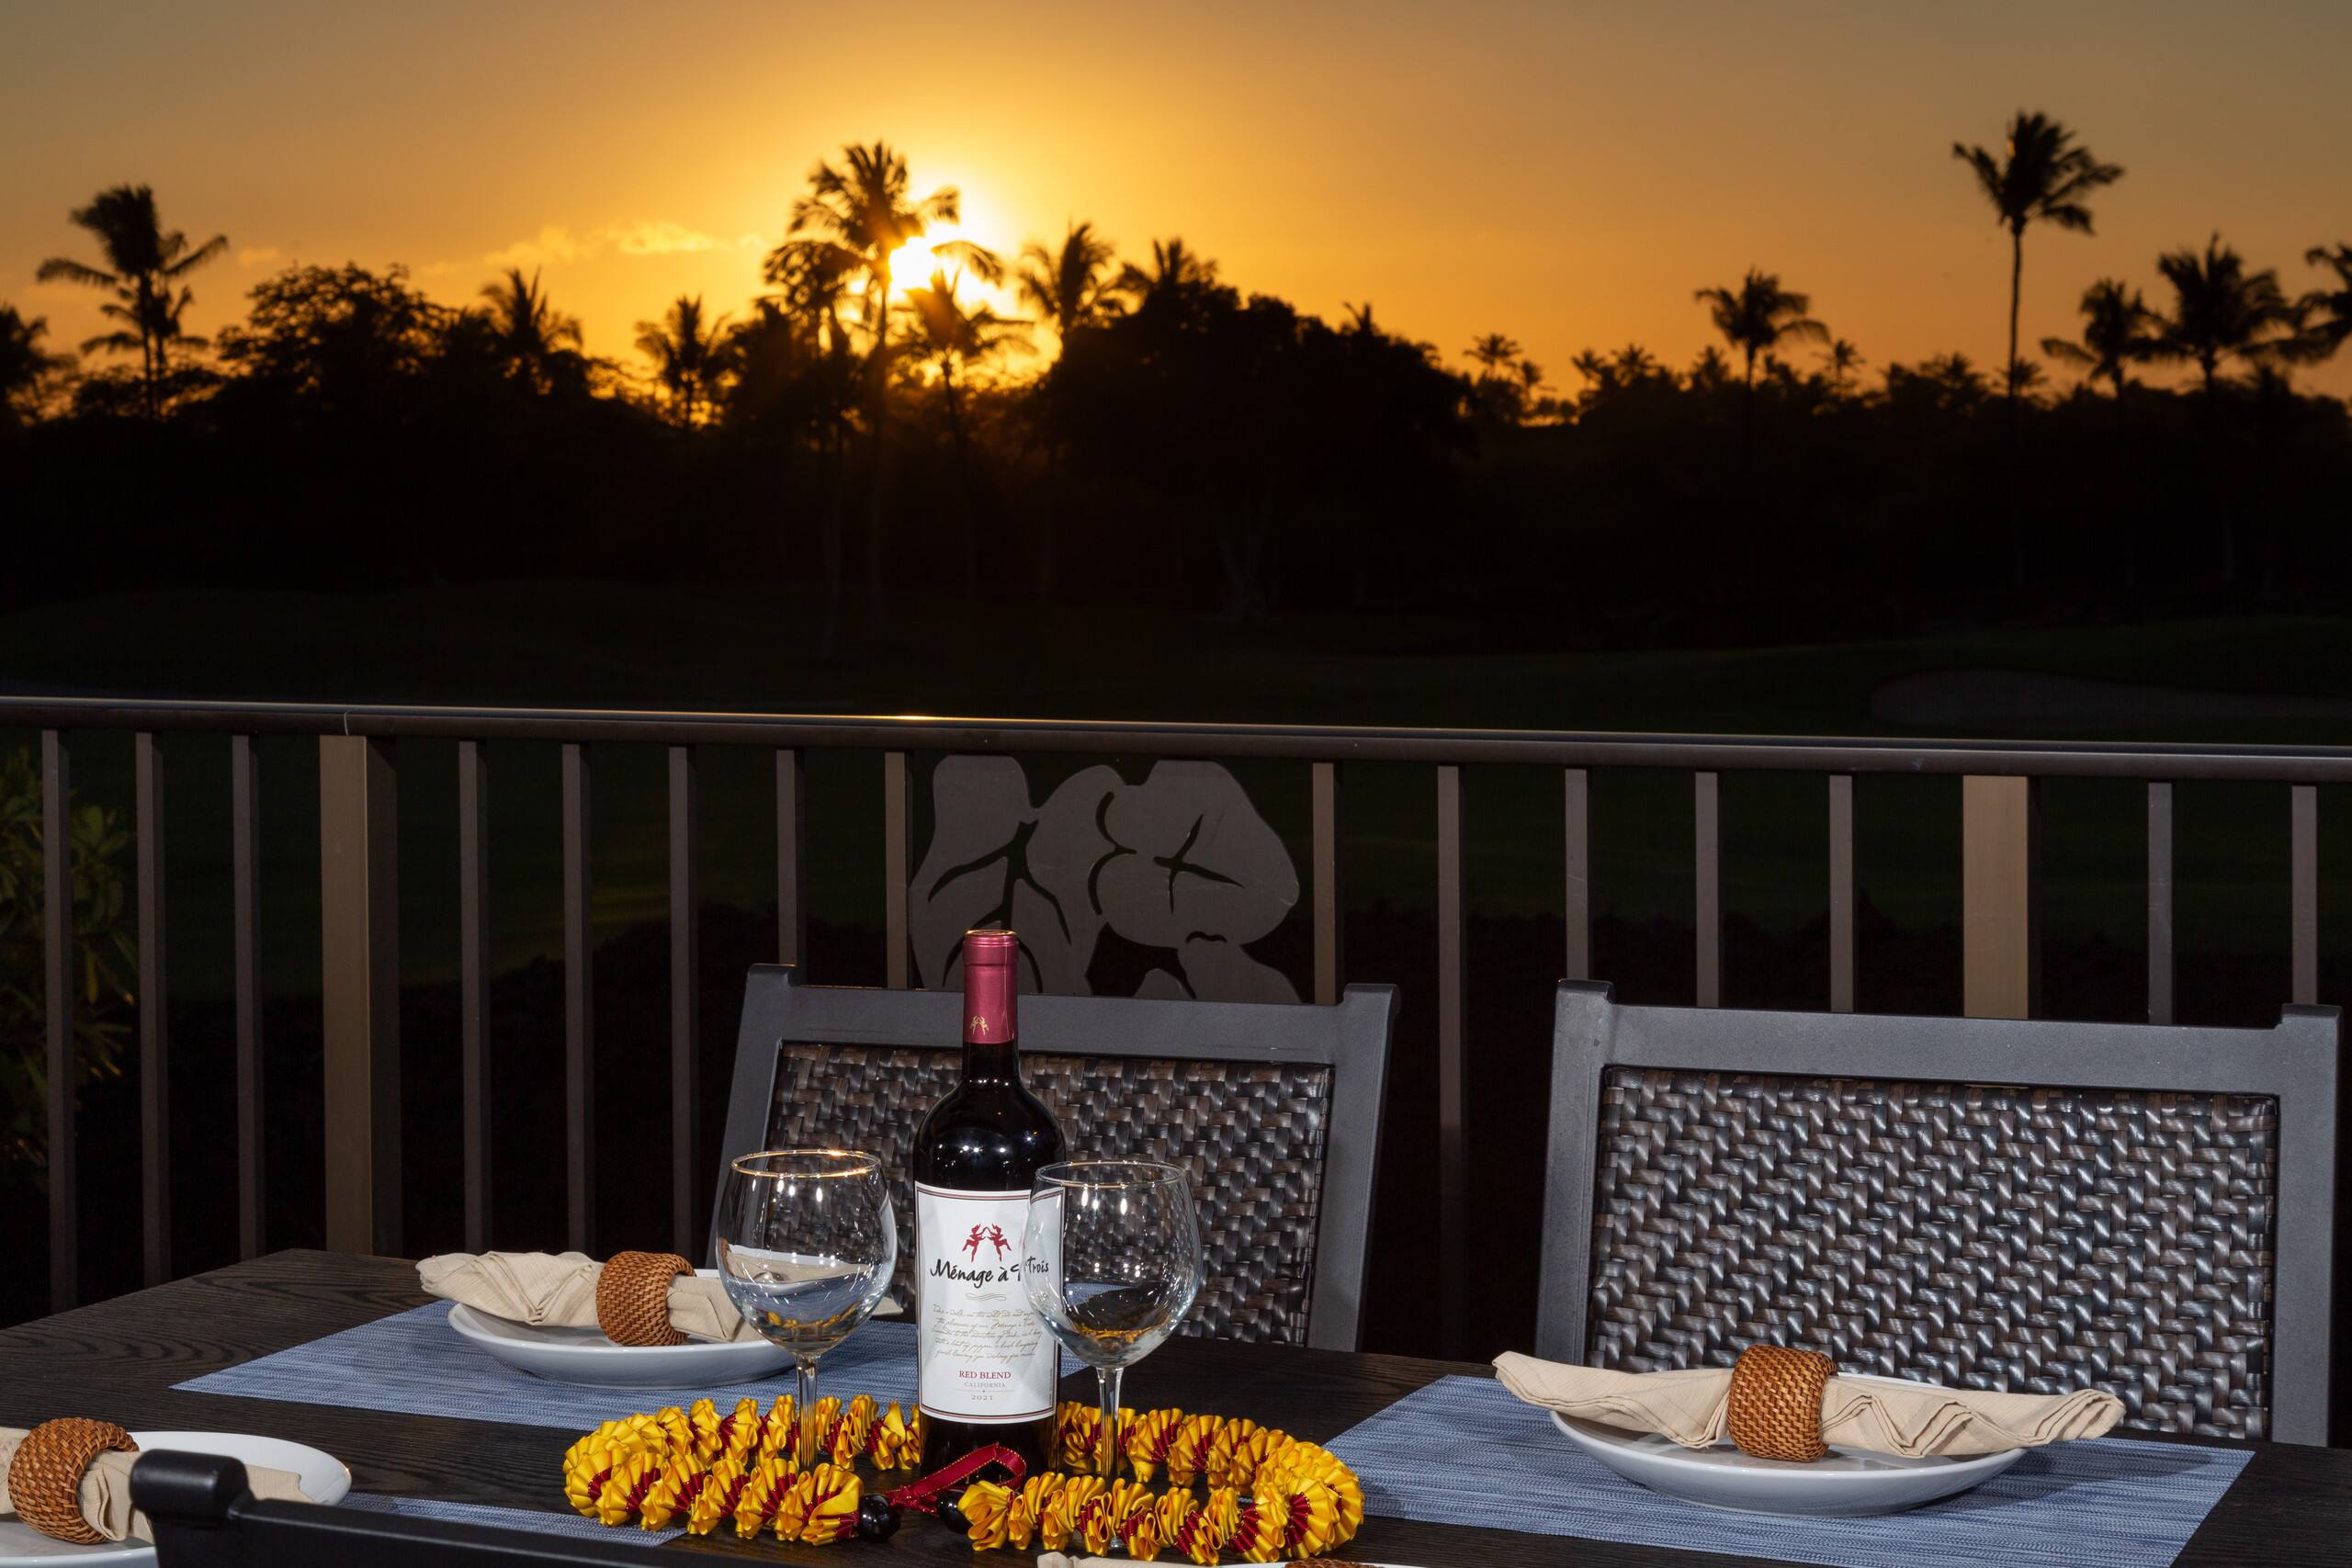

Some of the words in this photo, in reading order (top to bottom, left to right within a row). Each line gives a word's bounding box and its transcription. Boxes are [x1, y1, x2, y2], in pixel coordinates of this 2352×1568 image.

[930, 1258, 993, 1289] Ménage
[997, 1266, 1009, 1282] à
[958, 1370, 978, 1379] RED
[979, 1371, 1012, 1380] BLEND
[963, 1381, 1006, 1389] CALIFORNIA
